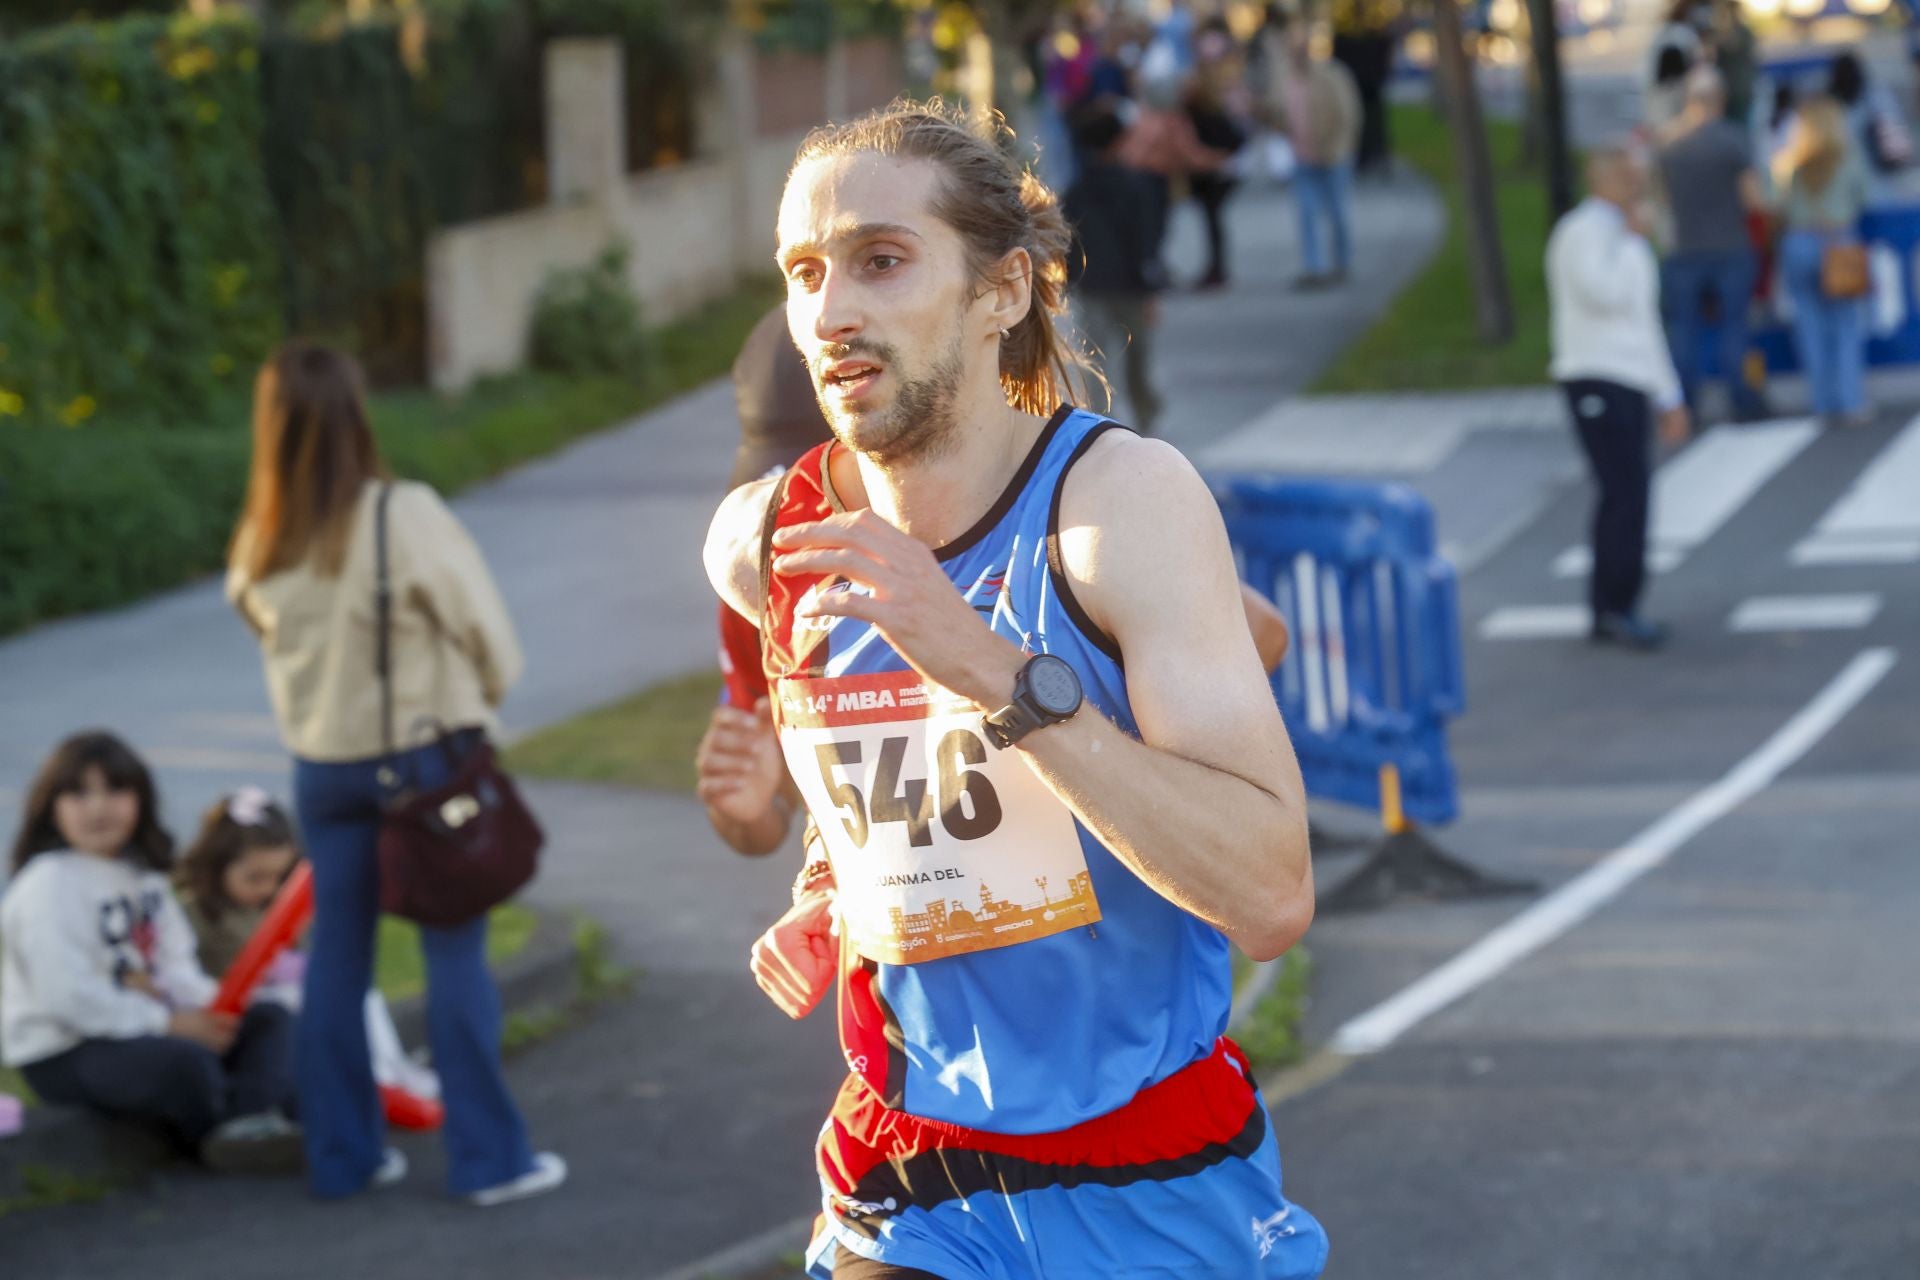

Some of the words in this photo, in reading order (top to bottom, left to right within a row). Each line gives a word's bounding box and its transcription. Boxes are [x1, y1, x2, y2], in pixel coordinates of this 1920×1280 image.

[836, 689, 896, 713] MBA
[814, 728, 1003, 849] 546
[875, 872, 932, 888] UANMA
[934, 867, 965, 881] DEL
